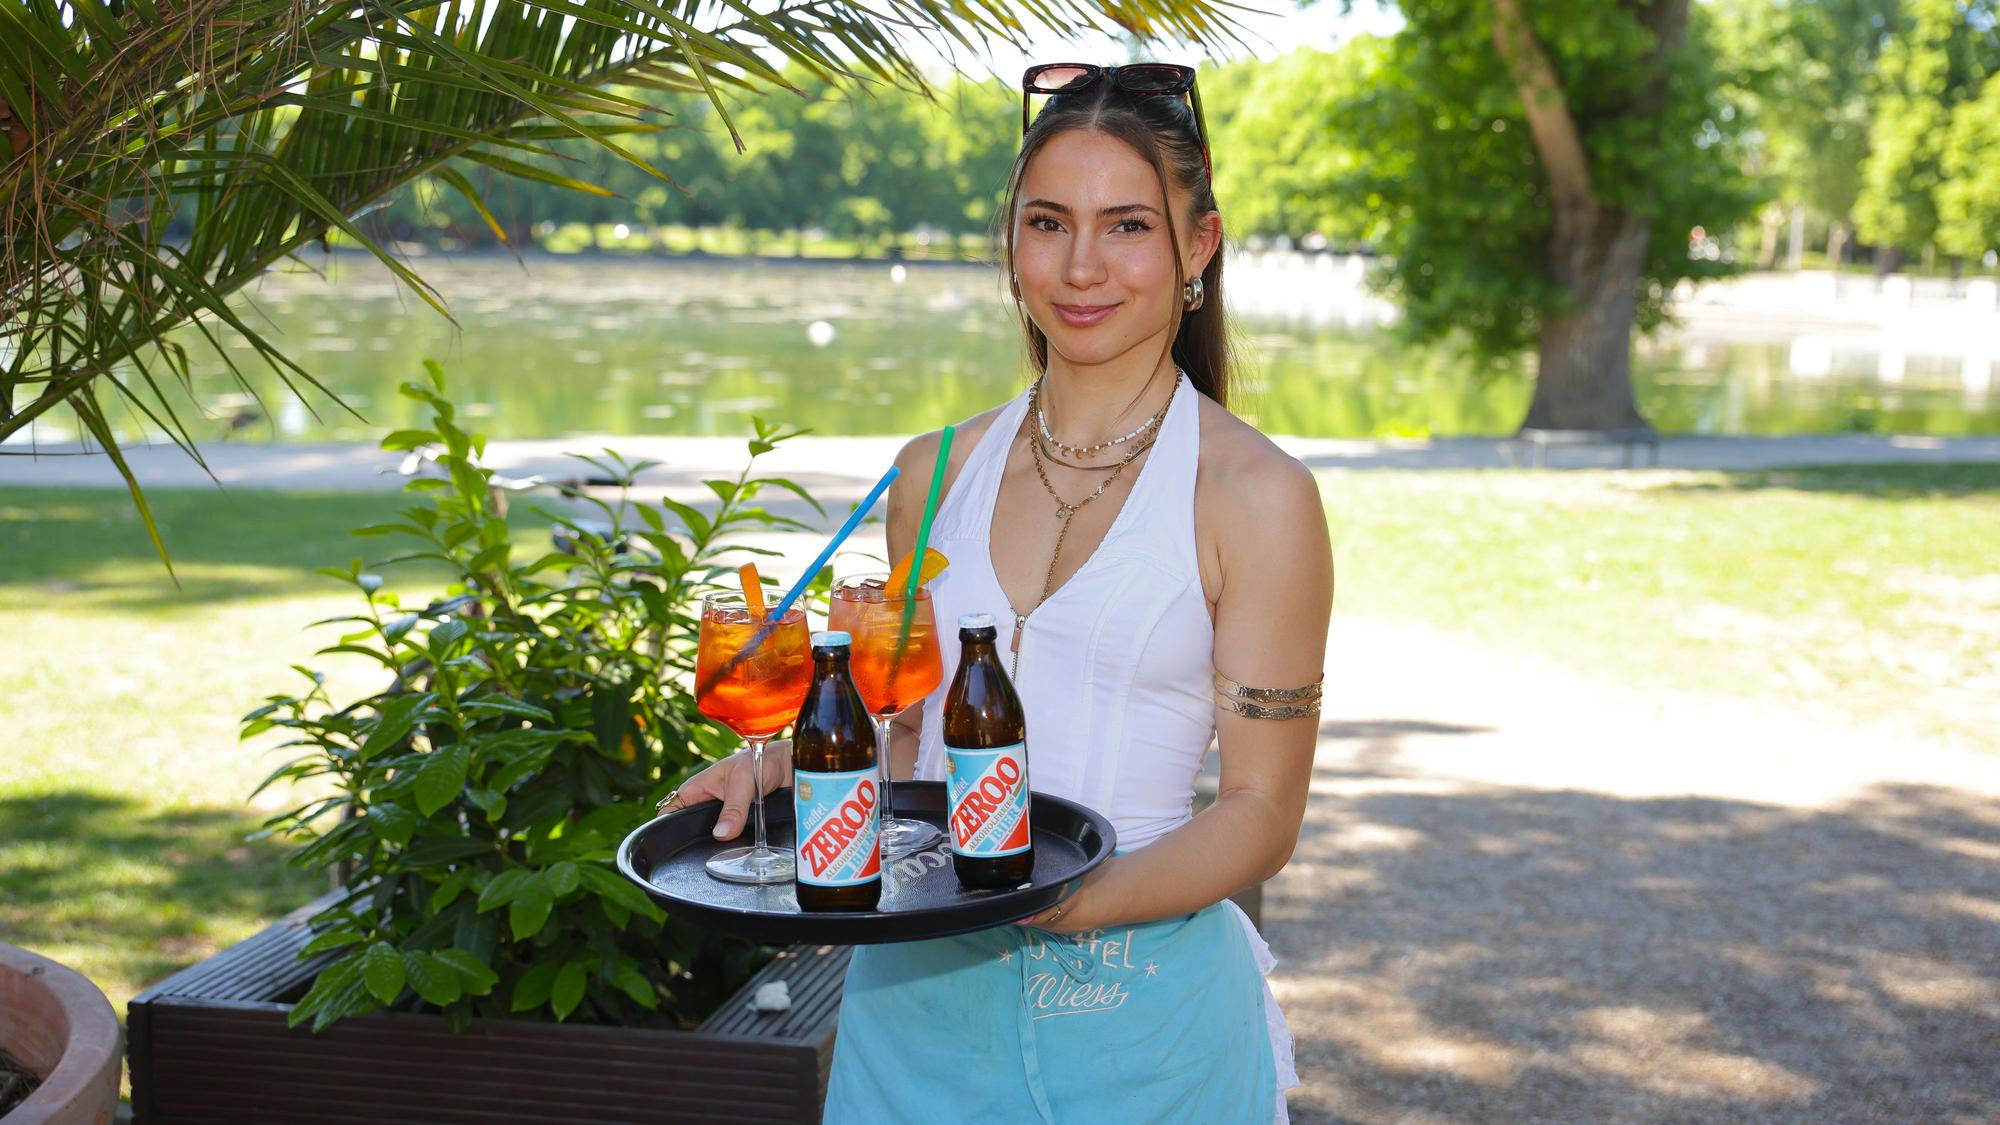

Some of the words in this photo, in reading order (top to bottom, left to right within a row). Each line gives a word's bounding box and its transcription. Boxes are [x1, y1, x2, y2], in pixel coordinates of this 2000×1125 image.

[968, 794, 1015, 851] ALKOHOLFREIES
[992, 804, 1019, 842] BIER
[851, 832, 875, 871] BIER
